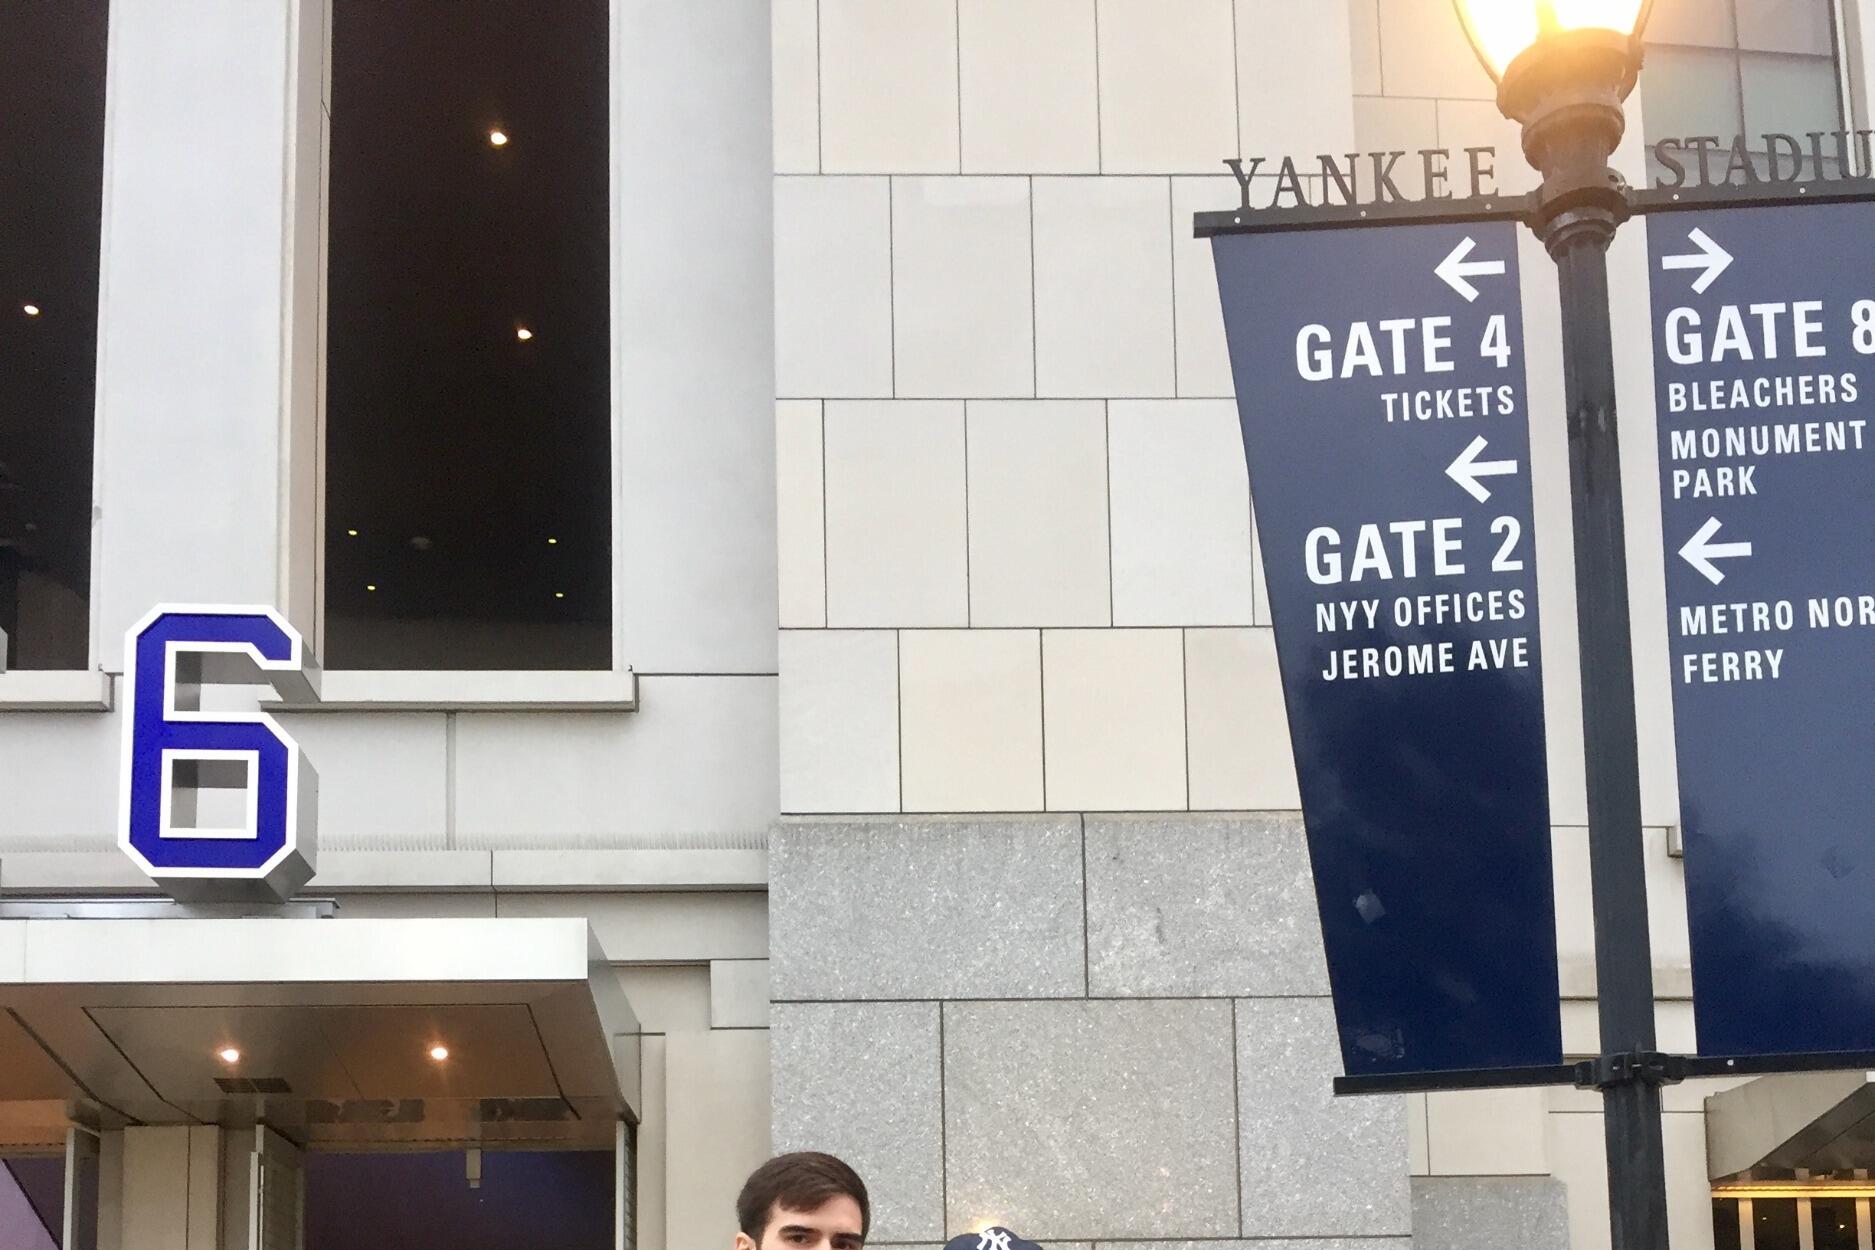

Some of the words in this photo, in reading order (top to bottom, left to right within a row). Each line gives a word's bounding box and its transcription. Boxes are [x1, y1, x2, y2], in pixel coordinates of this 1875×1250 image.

[1222, 147, 1500, 213] YANKEE
[1654, 130, 1875, 188] STADIU
[1295, 315, 1455, 382] GATE
[1479, 314, 1512, 369] 4
[1664, 300, 1827, 365] GATE
[1850, 299, 1875, 355] 8
[1380, 384, 1515, 423] TICKETS
[1668, 372, 1859, 413] BLEACHERS
[1670, 419, 1867, 461] MONUMENT
[1672, 465, 1758, 500] PARK
[1304, 517, 1466, 585] GATE
[1490, 515, 1524, 573] 2
[1316, 598, 1381, 633] NYY
[1394, 588, 1526, 627] OFFICES
[1679, 600, 1794, 637] METRO
[1808, 595, 1875, 629] NOR
[1322, 640, 1456, 681] JEROME
[1467, 637, 1529, 671] AVE
[1683, 648, 1784, 684] FERRY
[118, 603, 303, 879] 6
